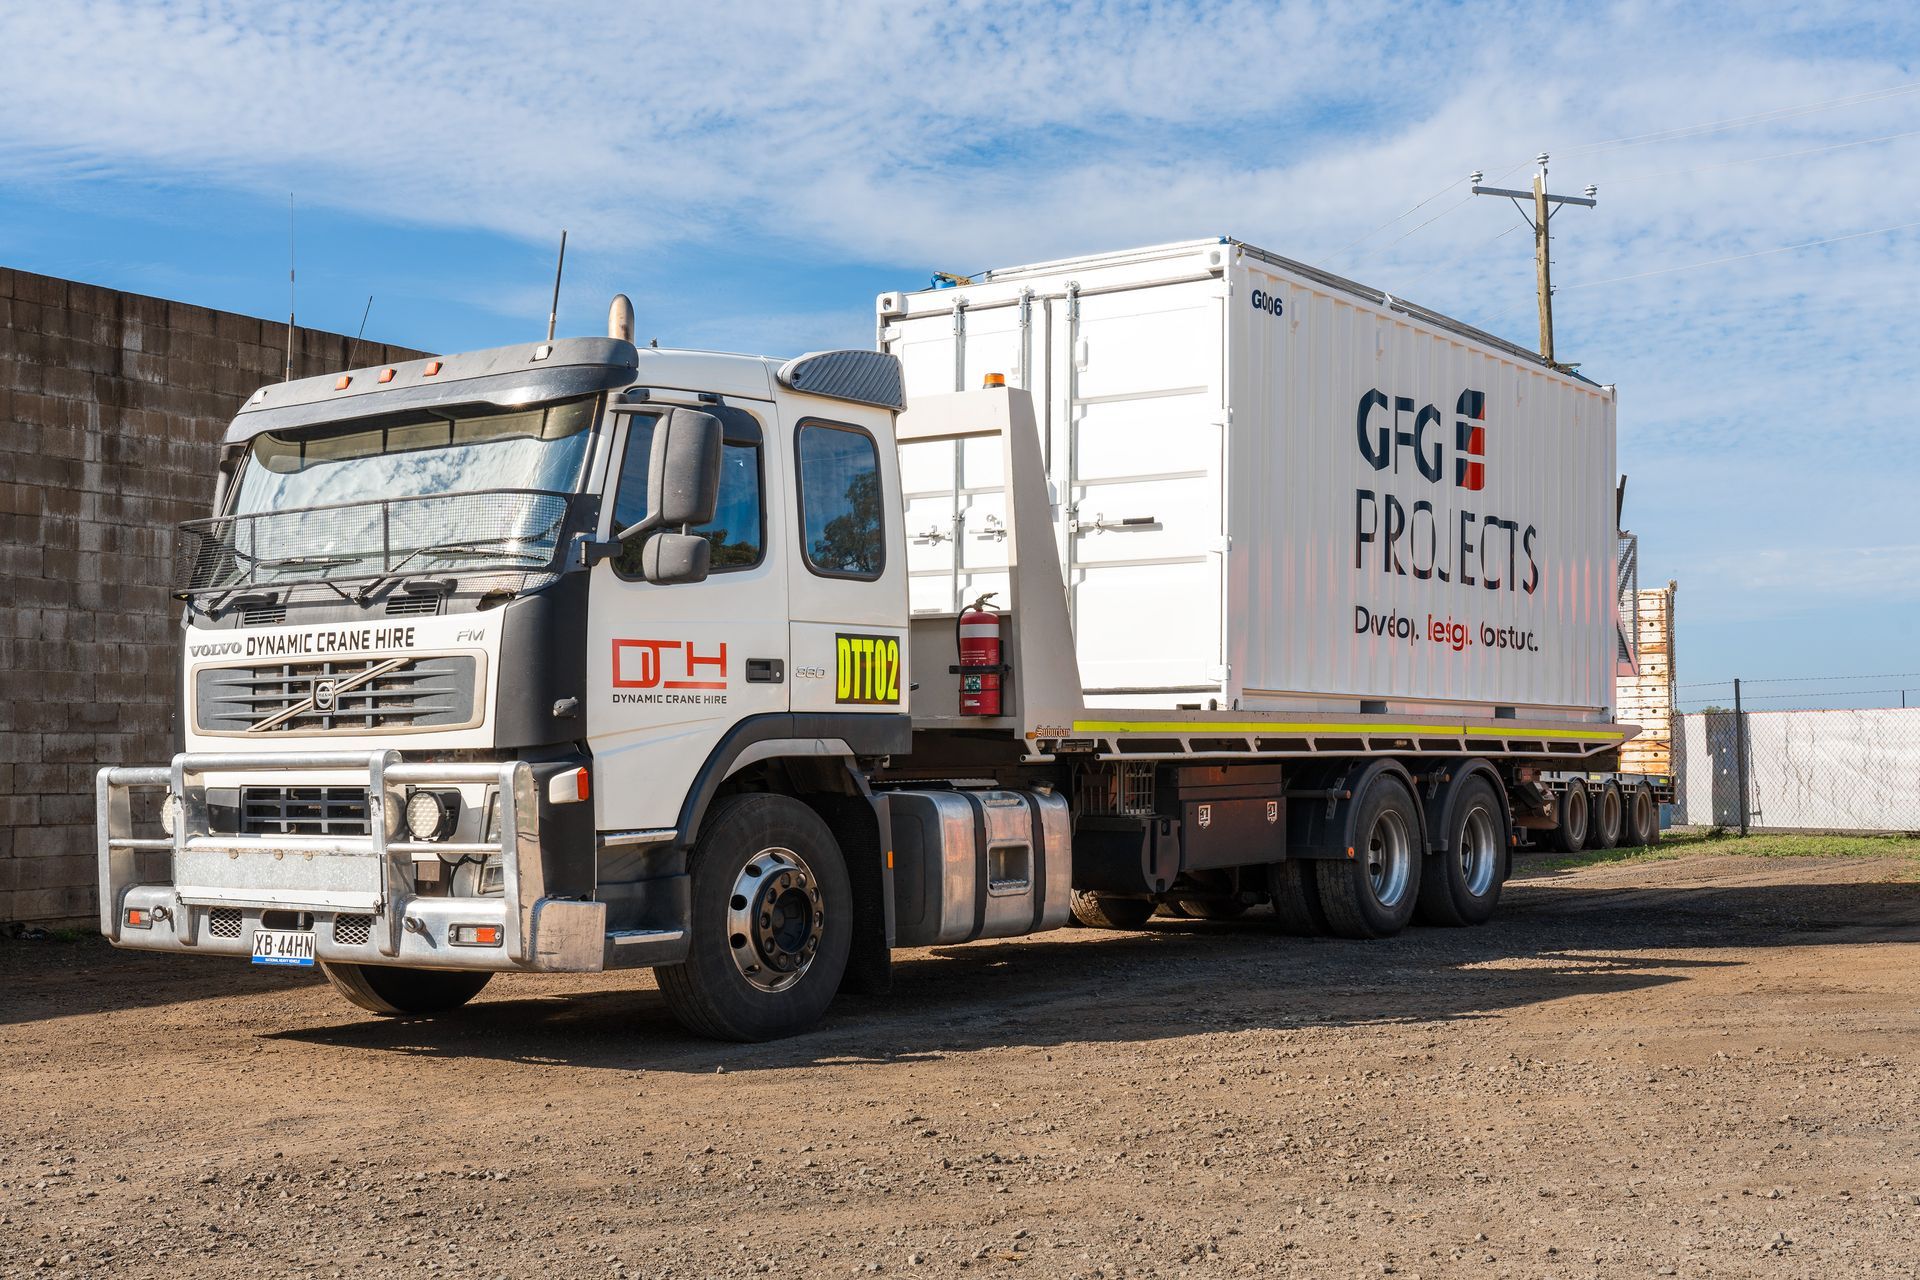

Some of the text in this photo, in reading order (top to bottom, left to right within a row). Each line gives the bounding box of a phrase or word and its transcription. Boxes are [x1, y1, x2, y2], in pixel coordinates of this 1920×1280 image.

[1251, 289, 1283, 317] G006
[1356, 387, 1443, 484] GFG
[1355, 488, 1540, 595] PROJECTS
[189, 626, 486, 657] VOLVO DYNAMIC CRANE HIRE FM
[1427, 613, 1473, 652] esig.
[837, 637, 899, 701] DTT02
[612, 694, 728, 705] DYNAMIC CRANE HIRE
